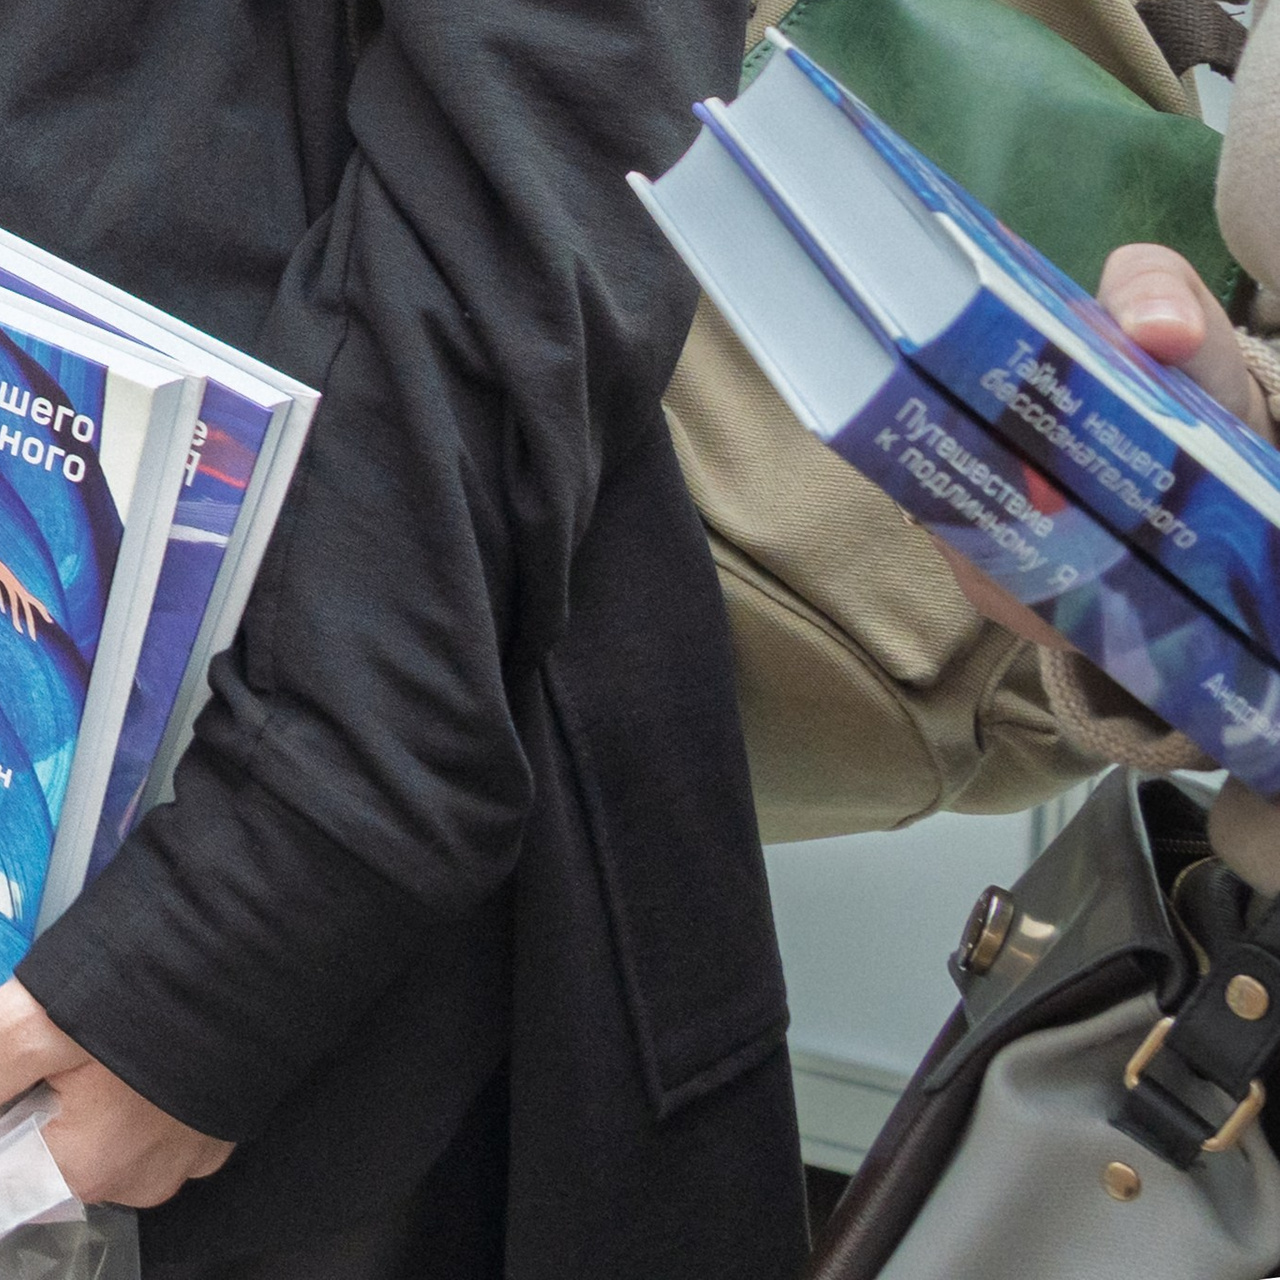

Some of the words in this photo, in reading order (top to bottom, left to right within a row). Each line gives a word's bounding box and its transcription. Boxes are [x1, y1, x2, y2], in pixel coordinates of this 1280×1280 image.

[895, 397, 1054, 538] Путешествие
[980, 368, 1197, 548] бессознательного
[1007, 340, 1083, 415] Тайны
[1082, 411, 1176, 491] нашего
[898, 447, 1048, 572] подлинному
[1048, 563, 1079, 590] Я
